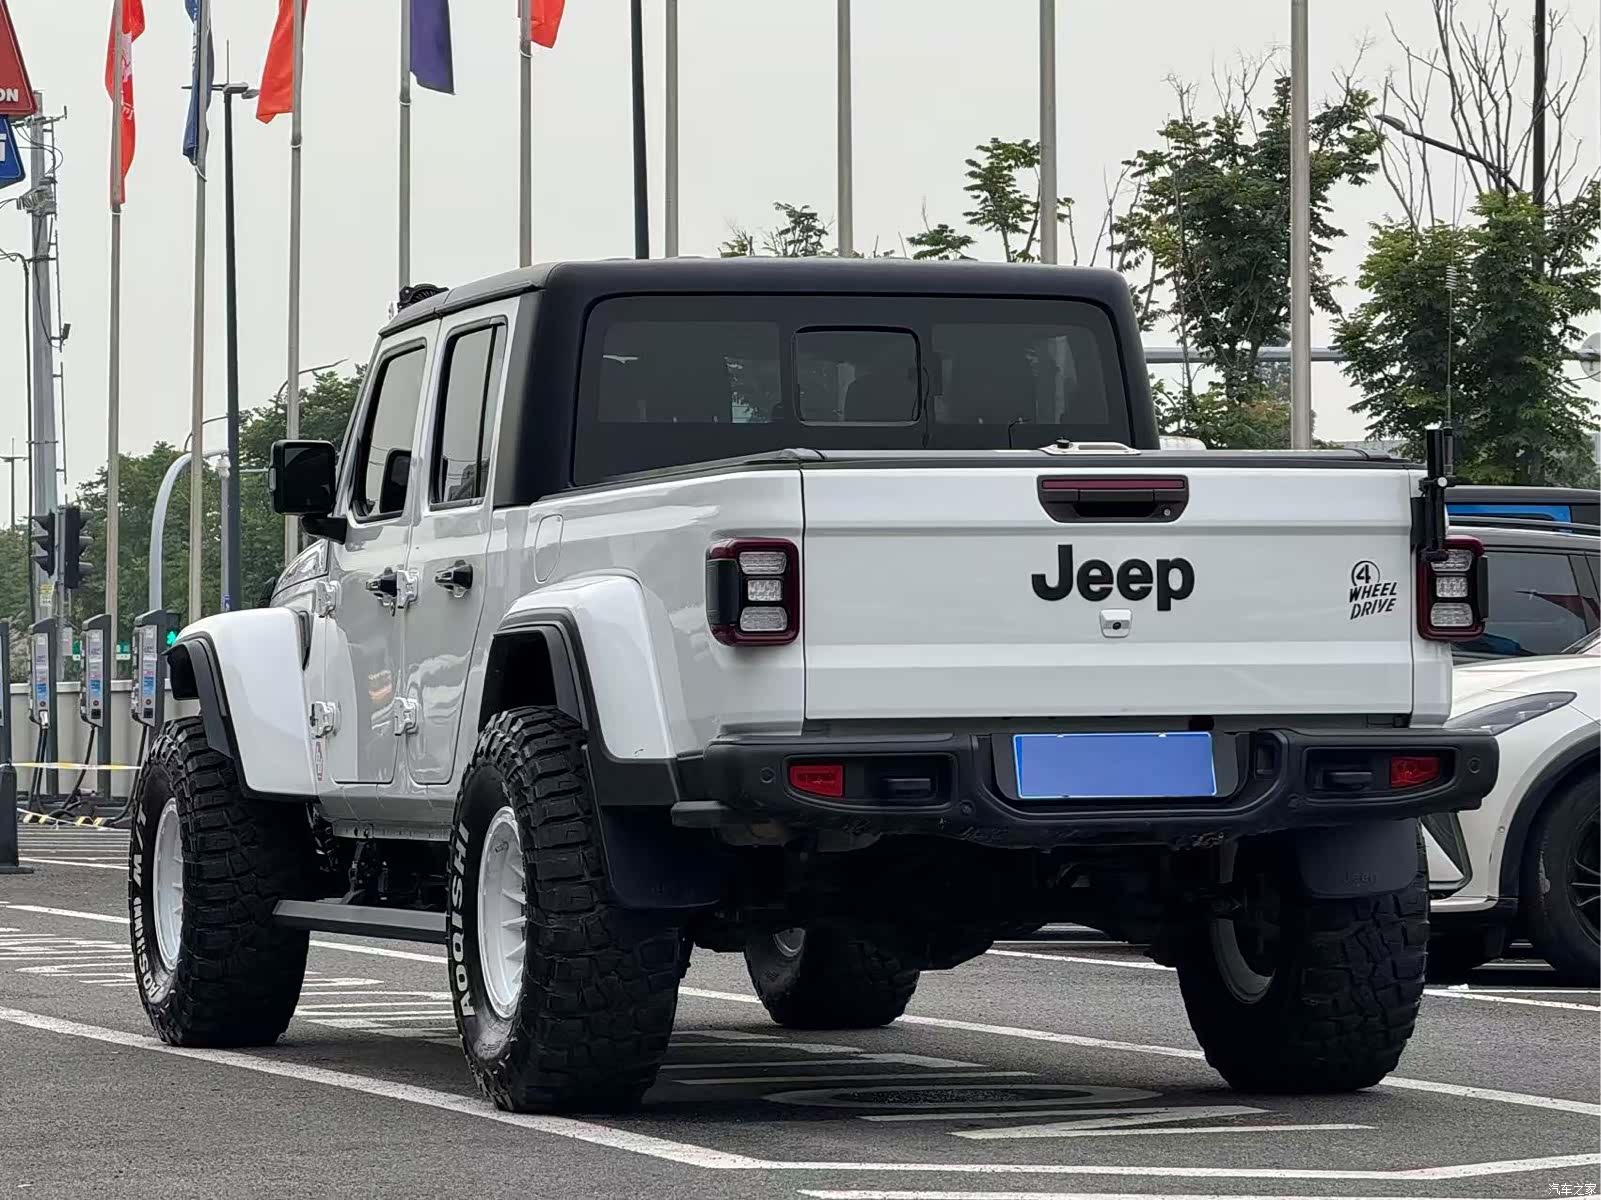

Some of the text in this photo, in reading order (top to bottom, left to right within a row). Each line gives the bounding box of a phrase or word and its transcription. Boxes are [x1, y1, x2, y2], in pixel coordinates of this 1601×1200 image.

[1031, 544, 1195, 611] Jeep
[1353, 562, 1375, 585] 4
[1349, 582, 1397, 603] WHEEL
[1350, 598, 1397, 620] DRIVE
[451, 821, 475, 1017] AOQISHI
